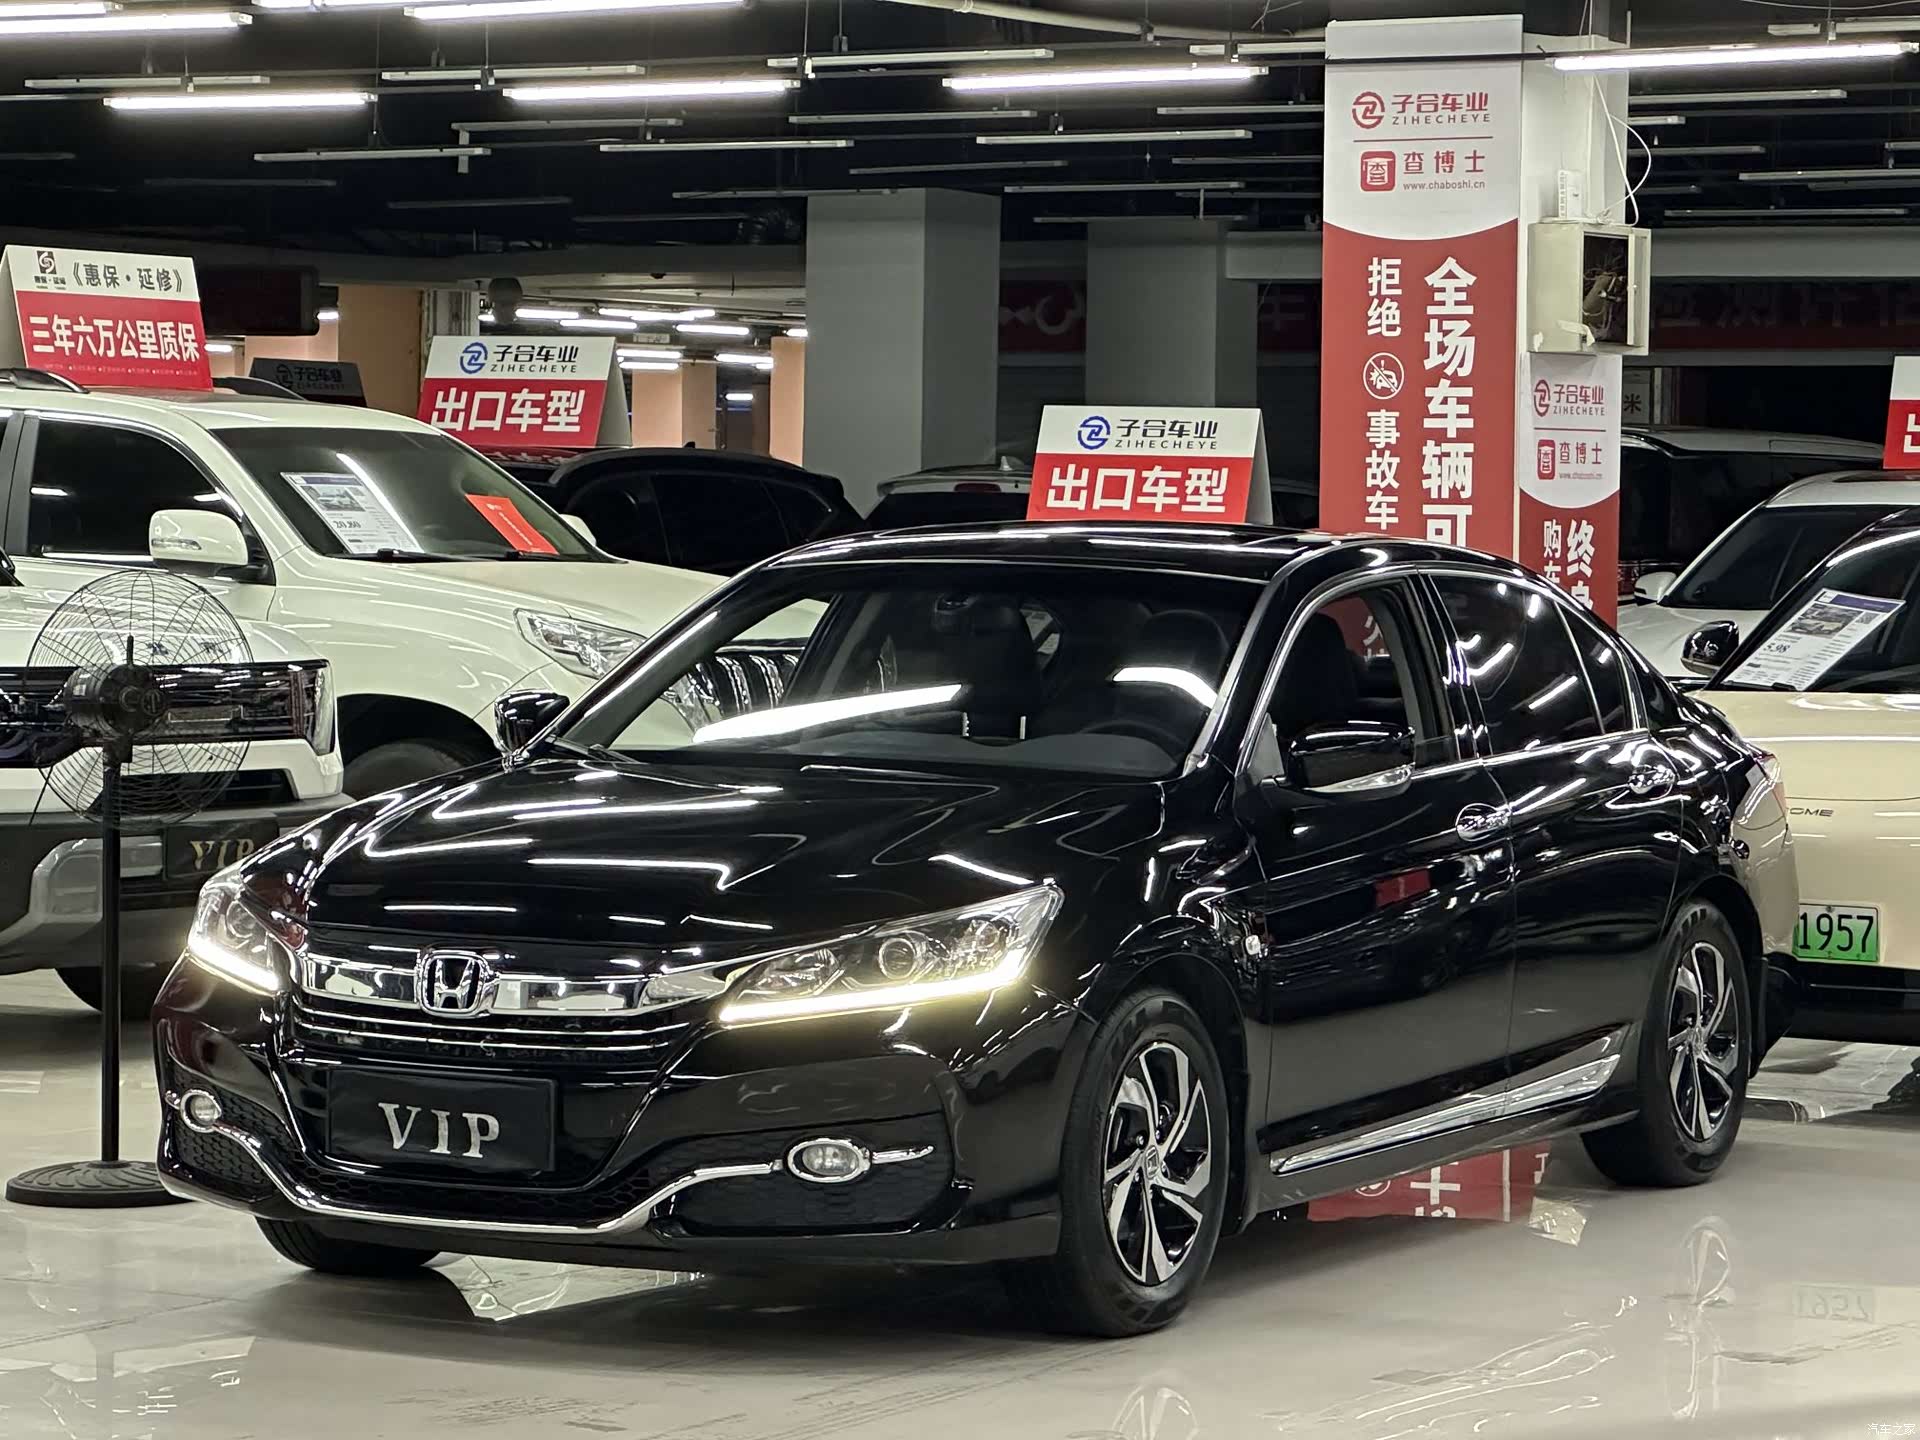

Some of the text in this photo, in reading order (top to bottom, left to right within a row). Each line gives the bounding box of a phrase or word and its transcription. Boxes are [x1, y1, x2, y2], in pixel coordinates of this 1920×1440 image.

[1391, 91, 1489, 114] 子合车业
[1391, 113, 1490, 126] ZIHECHEYE
[1403, 150, 1486, 175] 查博士
[1402, 179, 1486, 191] www.chaboshi.cn
[29, 314, 200, 362] 三年六万公里质保
[493, 344, 579, 363] 子合车业
[490, 364, 577, 373] ZIHECHEYE
[1364, 257, 1403, 530] 拒绝 事故车
[1421, 256, 1477, 547] 全场车辆可
[1553, 384, 1604, 405] 子合车业
[430, 387, 586, 433] 出口车型
[1552, 406, 1605, 416] ZIHECHEYE
[1116, 419, 1218, 439] 子合车业
[1115, 440, 1217, 450] ZIHECHEYE
[1559, 442, 1602, 465] 查博士
[1046, 463, 1229, 513] 出口车型
[1786, 807, 1834, 817] OME
[189, 838, 255, 870] VIP
[1797, 912, 1874, 953] 1957
[378, 1102, 500, 1158] VIP
